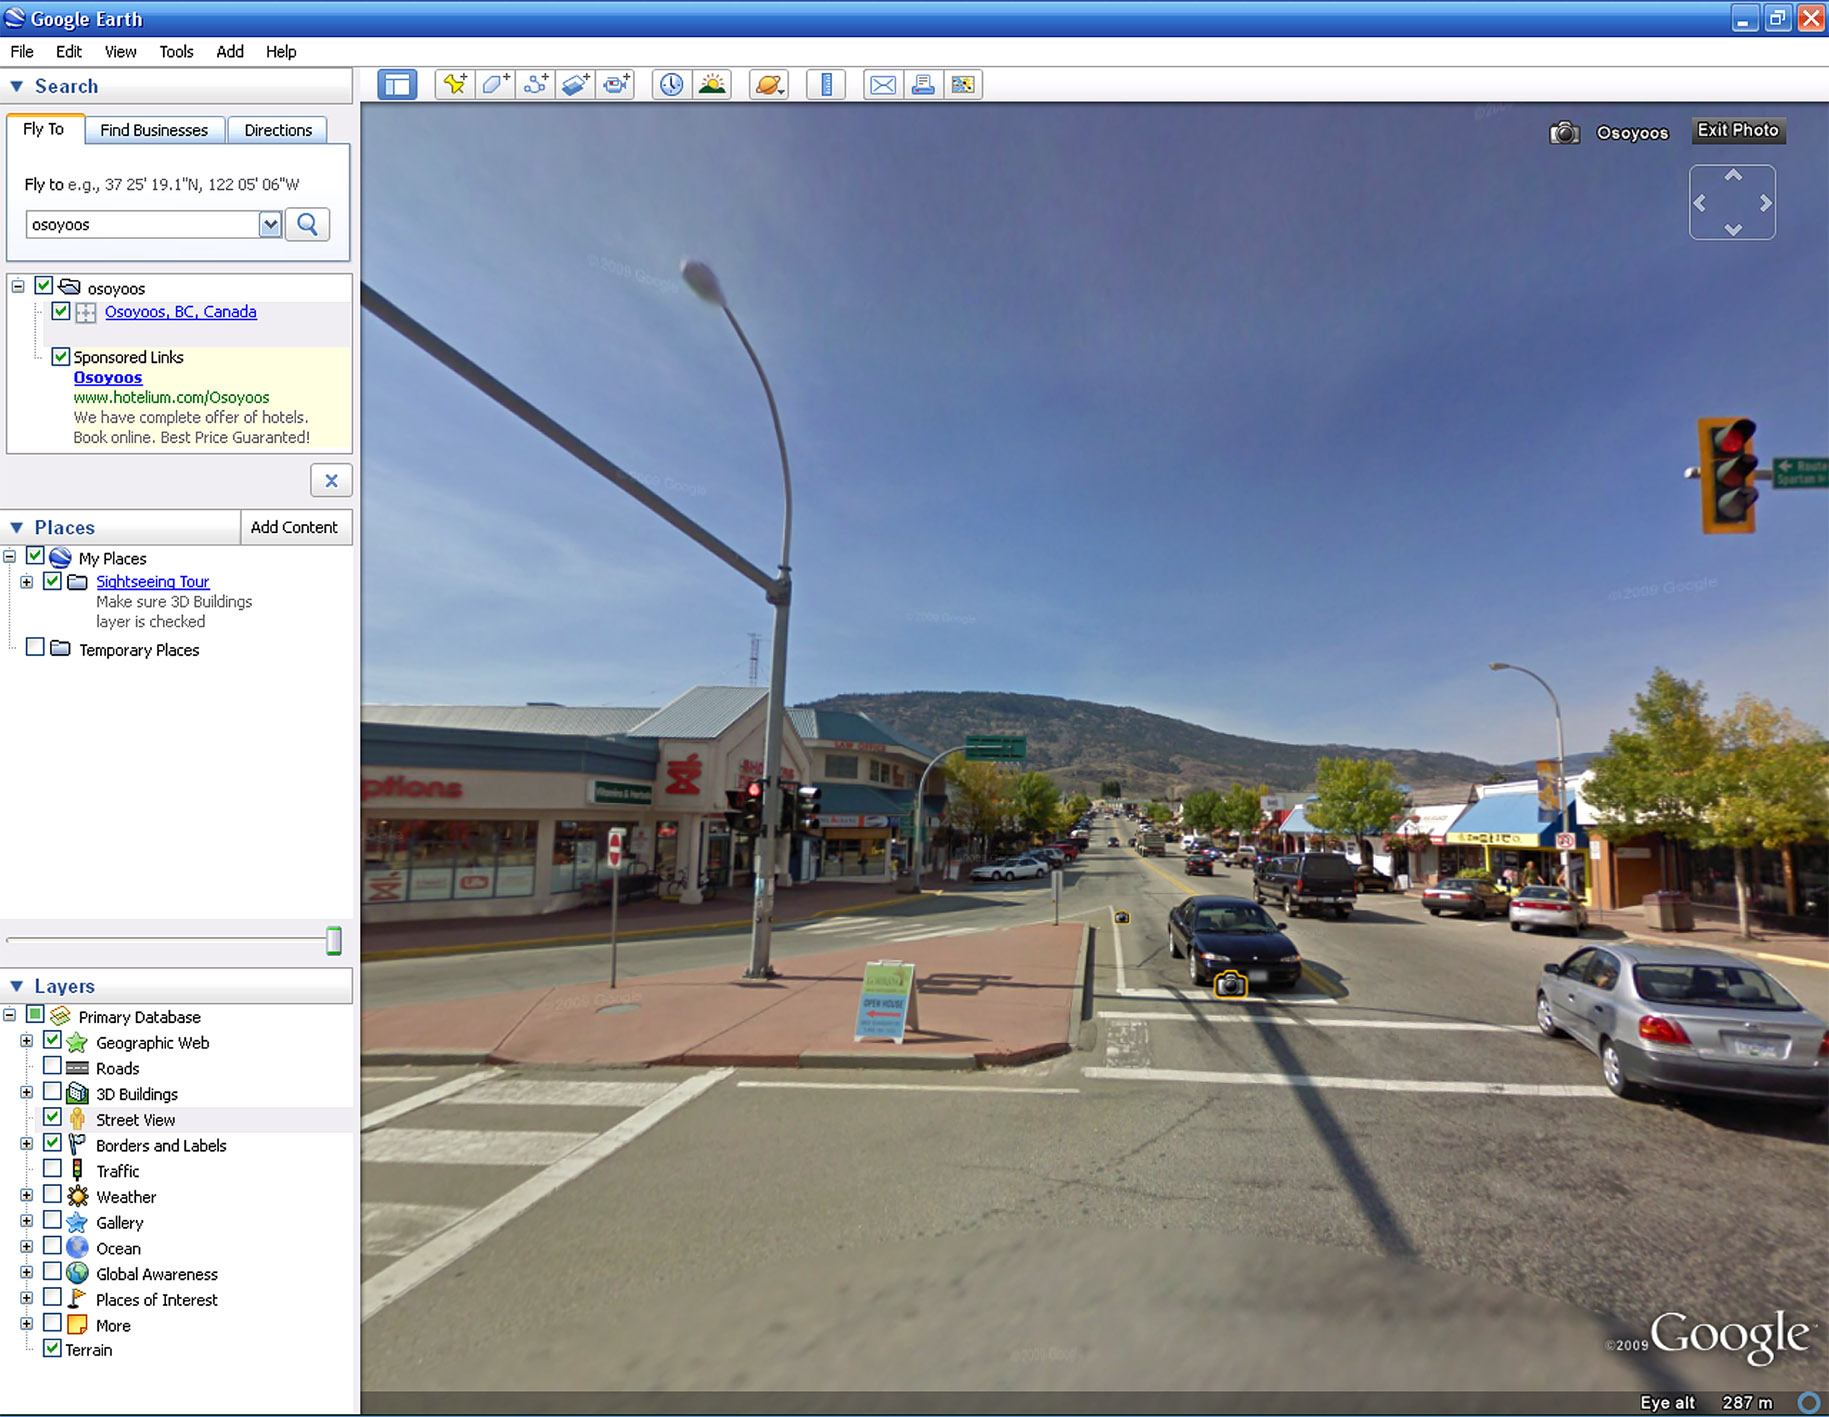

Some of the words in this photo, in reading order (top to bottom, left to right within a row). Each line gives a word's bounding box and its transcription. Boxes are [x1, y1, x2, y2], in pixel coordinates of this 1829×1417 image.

[31, 12, 90, 31] Google
[97, 11, 143, 27] Earth
[11, 44, 33, 58] File
[57, 44, 82, 58] Edit
[105, 45, 136, 58] View
[160, 44, 193, 58] Tools
[217, 44, 244, 58] Add
[267, 44, 296, 60] Help
[36, 78, 98, 93] Search
[24, 121, 44, 138] Fly
[48, 123, 64, 135] To
[101, 123, 129, 136] Find
[134, 124, 208, 136] Businesses
[246, 124, 312, 136] Directions
[1597, 126, 1669, 142] Osoyoos
[1698, 123, 1728, 137] Exit
[1733, 123, 1779, 137] Photo
[25, 177, 45, 193] Fly
[50, 178, 64, 191] to
[68, 181, 99, 193] e.g.,
[106, 179, 122, 190] 37
[127, 177, 146, 190] 25'
[153, 177, 202, 193] 19.1"N,
[210, 179, 233, 190] 122
[239, 177, 258, 190] 05'
[263, 177, 299, 190] 06"W
[33, 221, 89, 233] osoyoos
[88, 285, 145, 298] osoyoos
[105, 306, 170, 320] Osoyoos,
[174, 306, 201, 320] BC,
[204, 306, 258, 320] Canada
[74, 350, 146, 366] Sponsored
[151, 350, 184, 363] Links
[74, 371, 143, 386] Osoyoos
[74, 390, 269, 406] www.hotelium.com/Osoyoos
[74, 411, 96, 423] We
[101, 410, 135, 423] have
[140, 410, 200, 426] complete
[206, 410, 239, 423] offer
[244, 410, 257, 423] of
[263, 410, 308, 423] hotels.
[74, 430, 108, 443] Book
[111, 430, 155, 443] online.
[162, 431, 190, 443] Best
[196, 431, 228, 443] Price
[233, 430, 309, 443] Guaranted!
[36, 520, 95, 535] Places
[251, 520, 278, 533] Add
[283, 521, 338, 533] Content
[80, 553, 99, 568] My
[104, 551, 146, 565] Places
[97, 574, 176, 590] Sightseeing
[180, 576, 211, 591] Tour
[97, 594, 132, 608] Make
[137, 598, 166, 608] sure
[172, 596, 189, 608] 3D
[194, 594, 252, 610] Buildings
[97, 614, 130, 630] layer
[136, 616, 145, 627] is
[150, 614, 205, 627] checked
[80, 644, 152, 659] Temporary
[157, 643, 199, 656] Places
[36, 978, 95, 996] Layers
[80, 1011, 131, 1026] Primary
[136, 1010, 201, 1023] Database
[97, 1035, 173, 1052] Geographic
[178, 1035, 209, 1049] Web
[97, 1061, 139, 1075] Roads
[97, 1088, 115, 1100] 3D
[120, 1087, 178, 1103] Buildings
[97, 1114, 139, 1126] Street
[144, 1114, 175, 1126] View
[97, 1138, 149, 1152] Borders
[154, 1138, 178, 1152] and
[184, 1138, 226, 1152] Labels
[97, 1164, 139, 1178] Traffic
[97, 1190, 156, 1203] Weather
[97, 1215, 144, 1232] Gallery
[97, 1242, 141, 1255] Ocean
[97, 1267, 138, 1280] Global
[143, 1268, 218, 1280] Awareness
[97, 1292, 140, 1306] Places
[144, 1292, 158, 1306] of
[163, 1294, 218, 1306] Interest
[97, 1320, 131, 1332] More
[66, 1344, 112, 1356] Terrain
